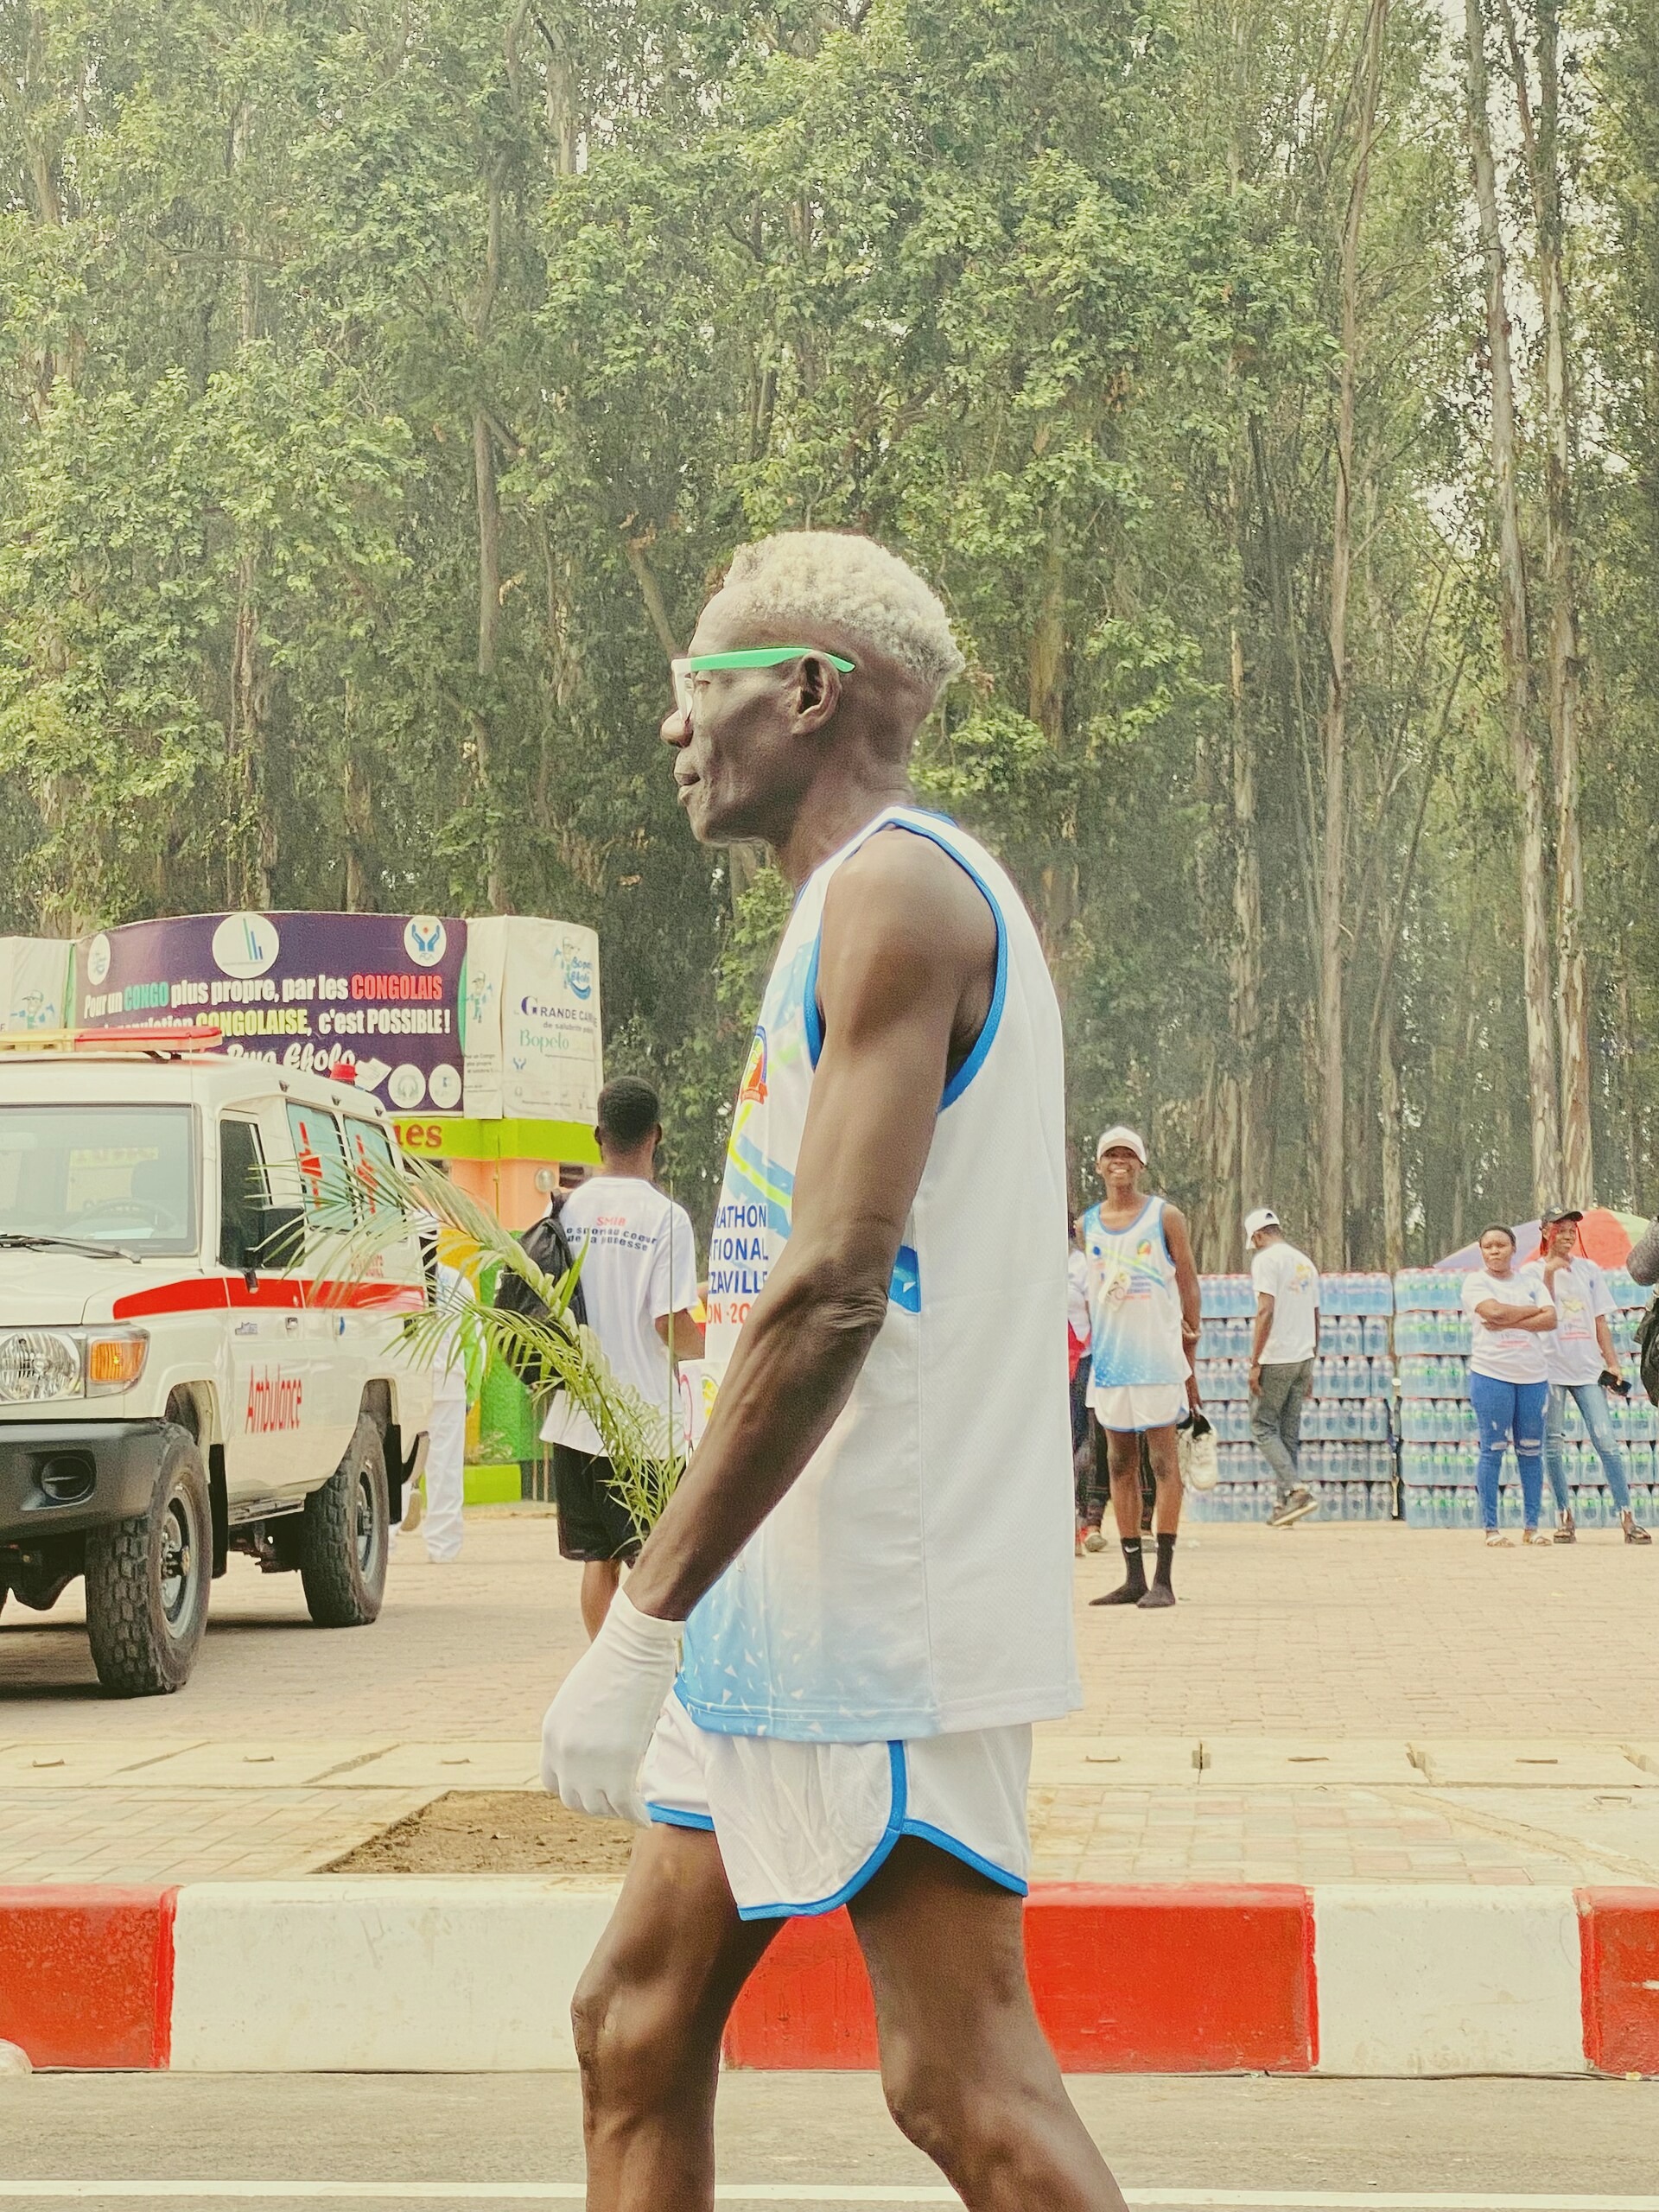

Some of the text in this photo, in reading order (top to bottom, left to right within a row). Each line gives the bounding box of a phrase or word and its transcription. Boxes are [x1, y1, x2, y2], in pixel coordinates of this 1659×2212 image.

[84, 973, 442, 1020] Pour un CONGO plus propre, par les CONGOLAIS
[521, 995, 577, 1020] GRANDE
[318, 1008, 365, 1034] c'est
[245, 1364, 302, 1434] Ambulance
